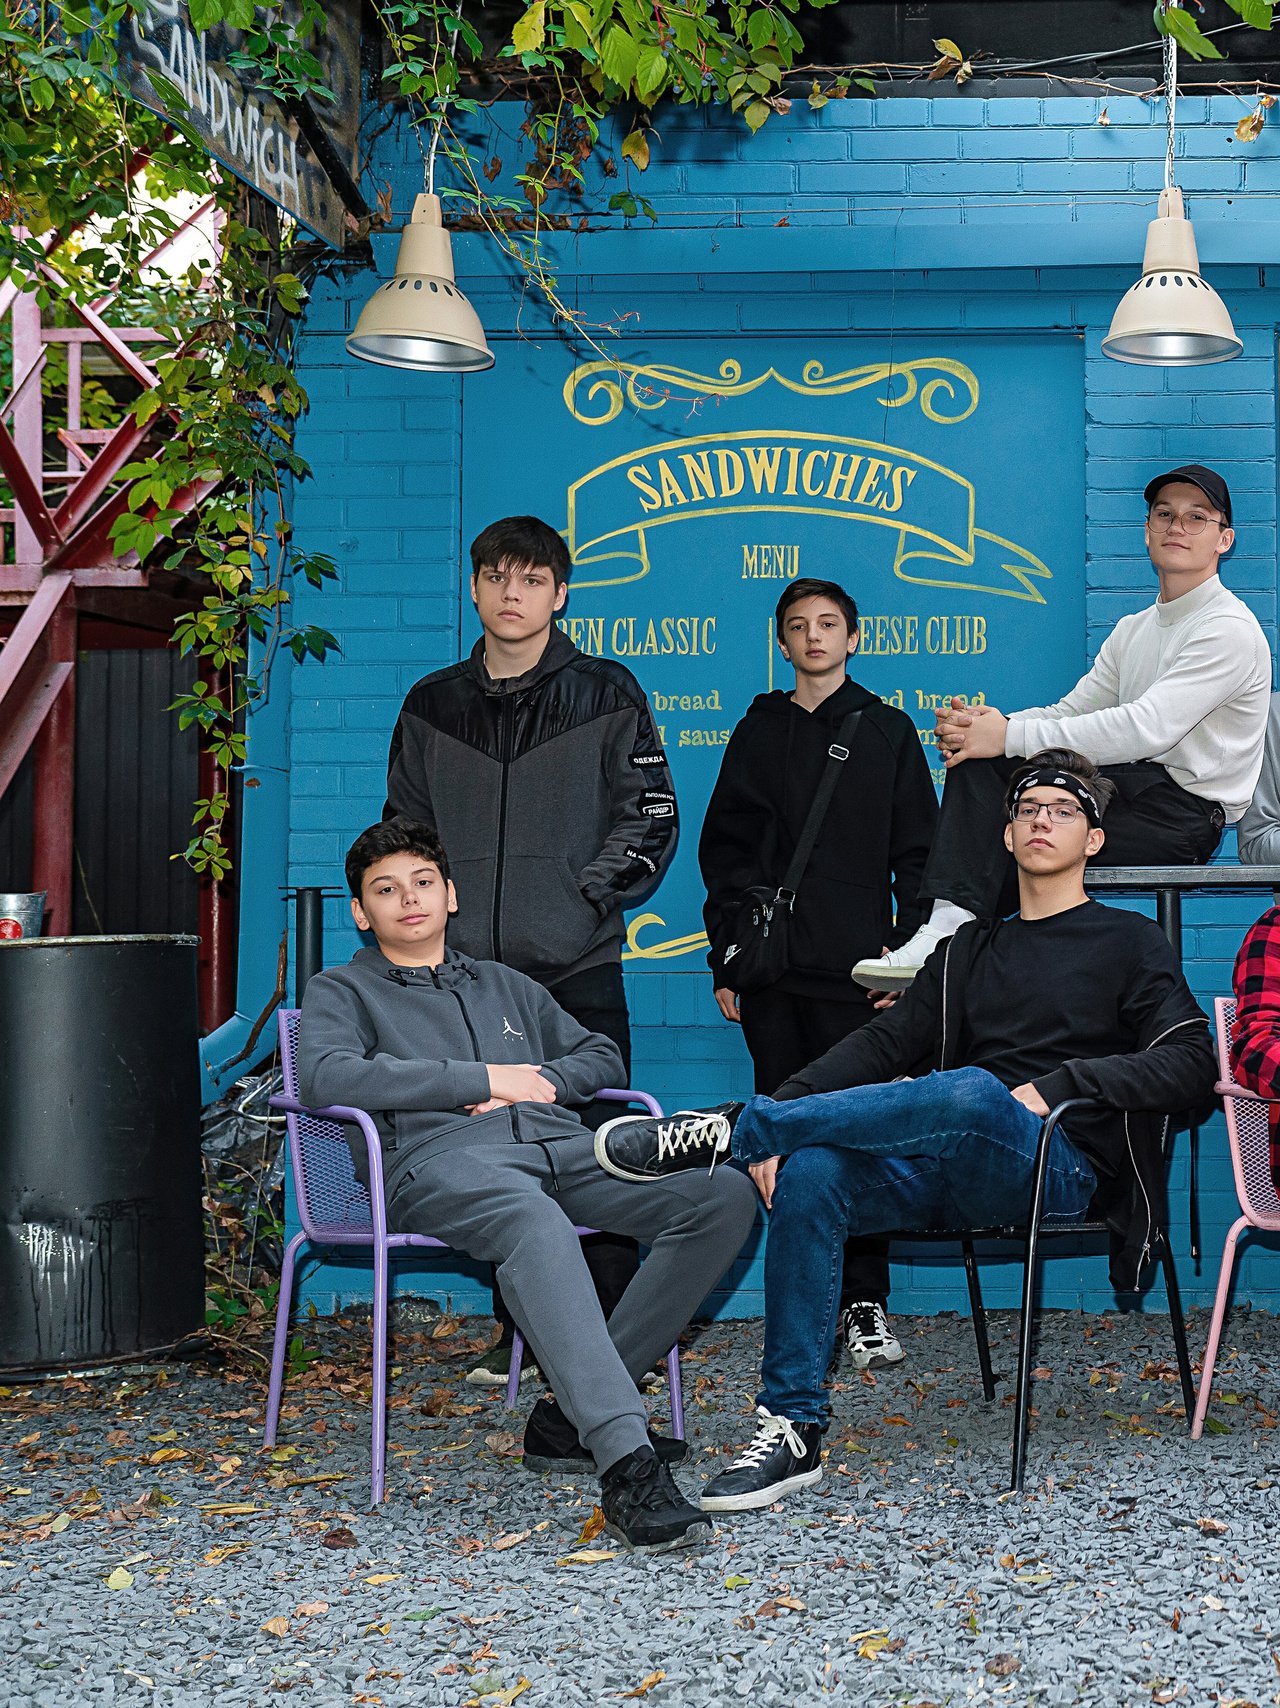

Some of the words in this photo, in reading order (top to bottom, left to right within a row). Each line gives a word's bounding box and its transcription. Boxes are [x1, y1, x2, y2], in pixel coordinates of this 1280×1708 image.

[626, 446, 918, 514] SANDWICHES
[741, 544, 800, 579] MENU
[611, 616, 717, 656] CLASSIC
[855, 616, 919, 655] EESE
[925, 616, 987, 655] CLUB
[652, 689, 723, 711] bread
[678, 729, 731, 747] saus
